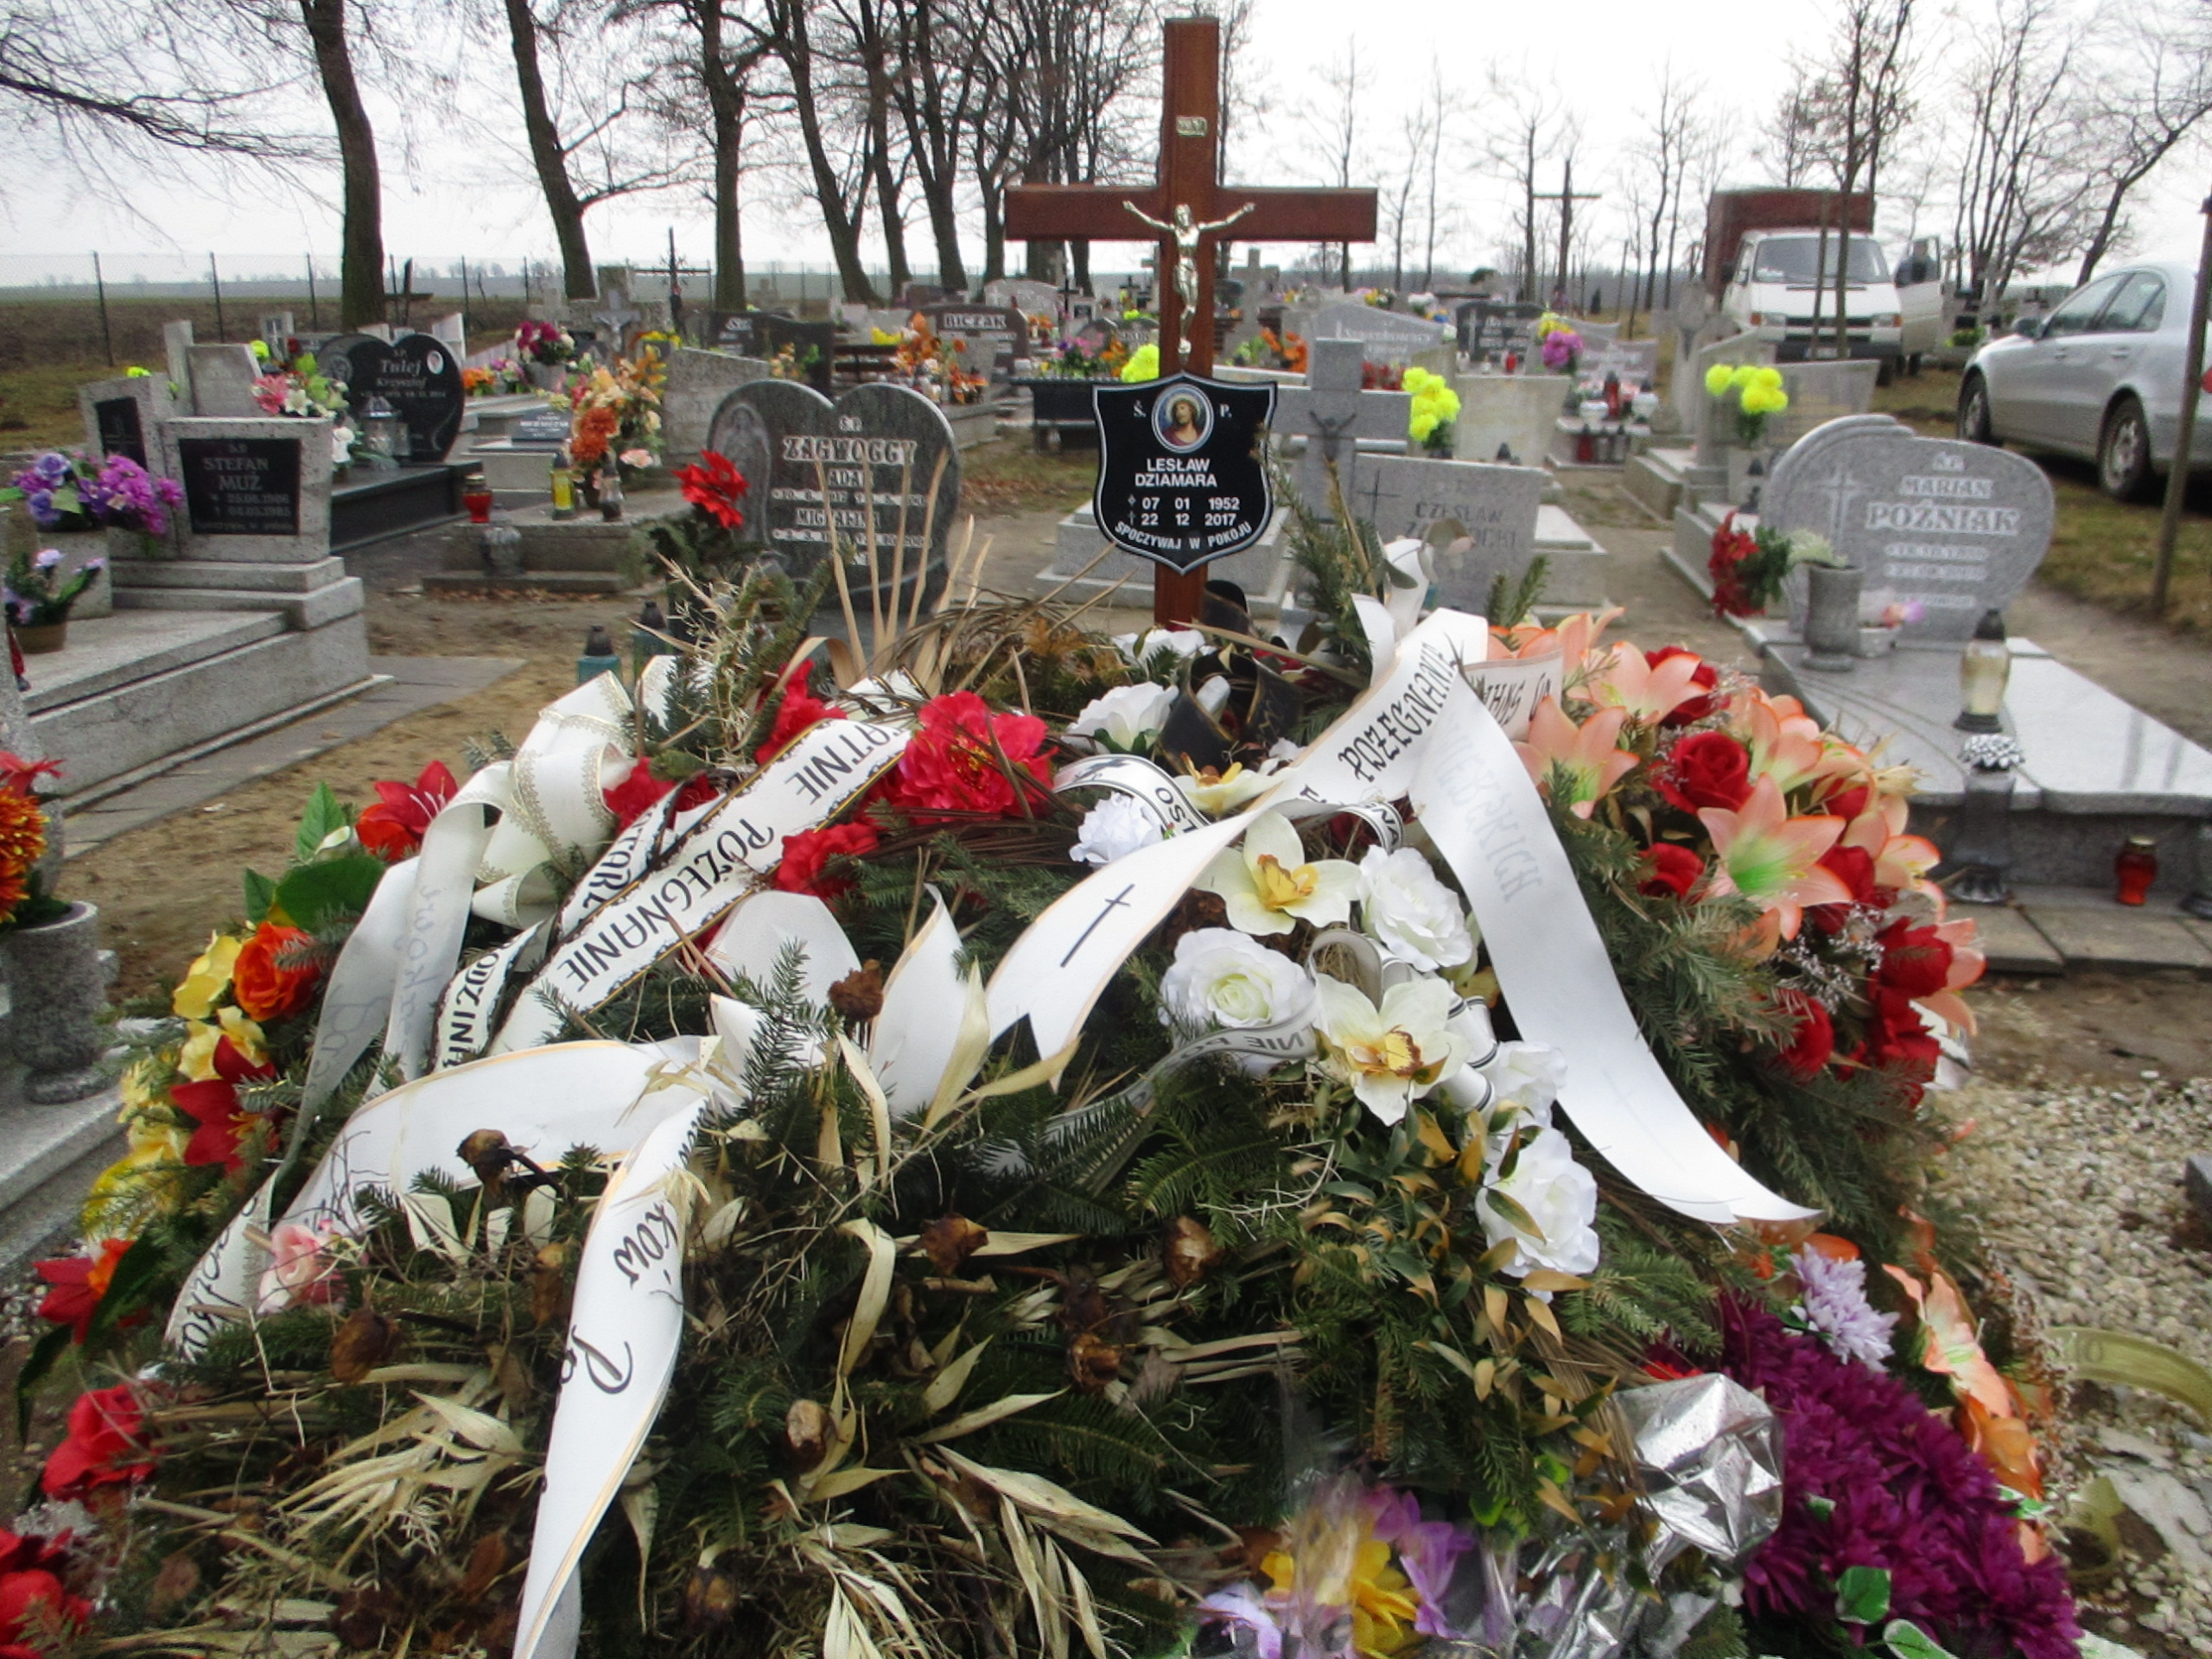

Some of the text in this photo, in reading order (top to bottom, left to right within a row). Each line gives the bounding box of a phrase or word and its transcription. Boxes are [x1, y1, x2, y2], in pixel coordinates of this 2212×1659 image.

[203, 457, 269, 471] STEFAN
[1147, 458, 1211, 472] LESŁAW
[1135, 474, 1217, 488] DZIAMARA
[1141, 497, 1240, 510] 07 01 1952
[1141, 513, 1236, 526] 22 12 2017
[1115, 520, 1252, 550] SPOCZYWAJ W POKOJU
